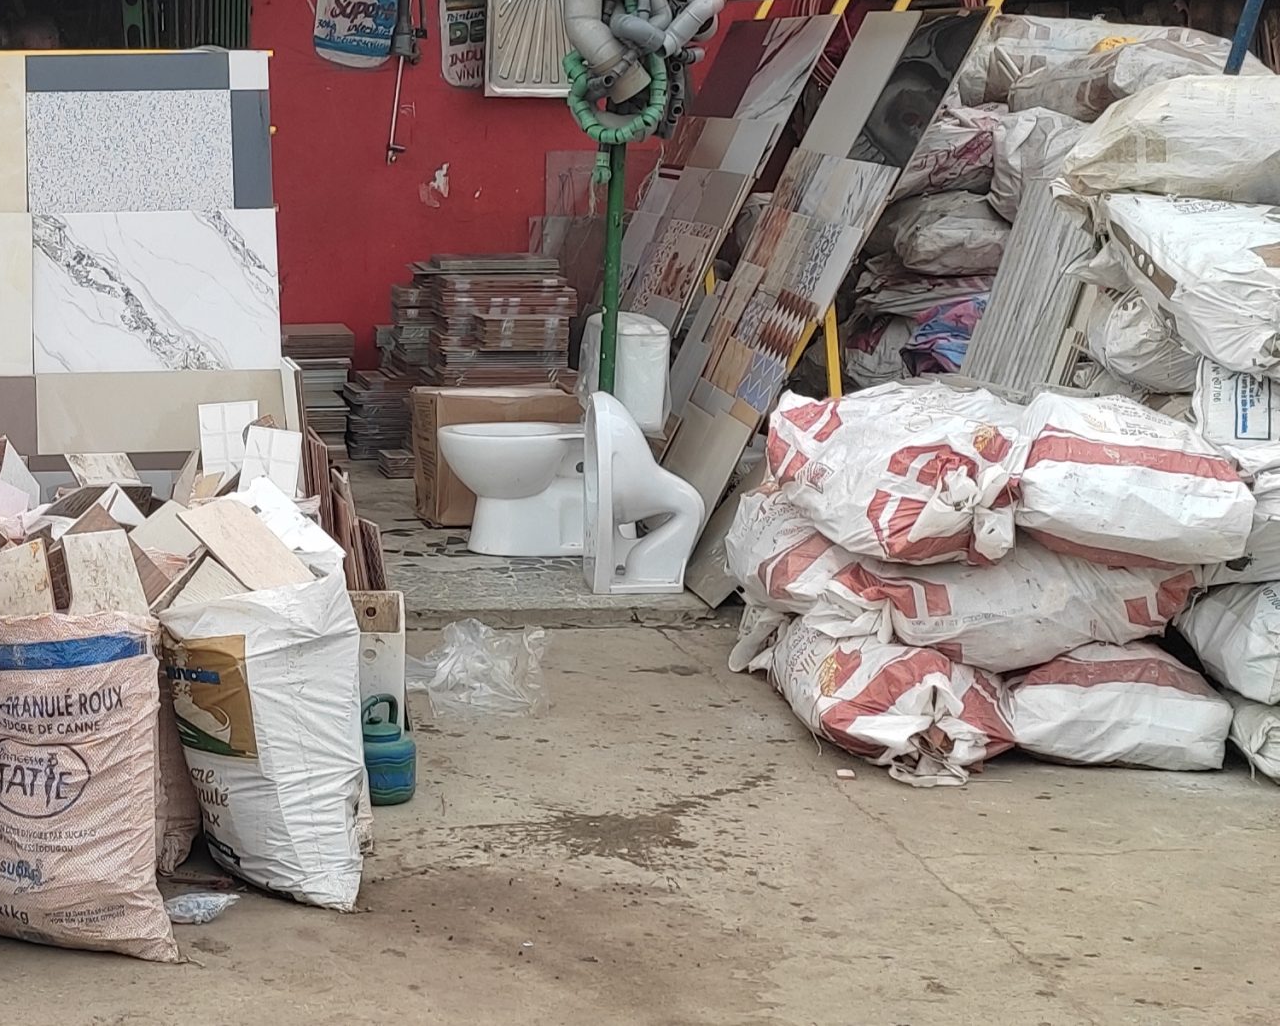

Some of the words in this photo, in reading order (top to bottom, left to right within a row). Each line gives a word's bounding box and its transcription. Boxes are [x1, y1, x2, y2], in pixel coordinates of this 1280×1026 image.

[79, 685, 123, 715] ROUX
[38, 724, 53, 735] DE
[57, 720, 101, 735] CANNE
